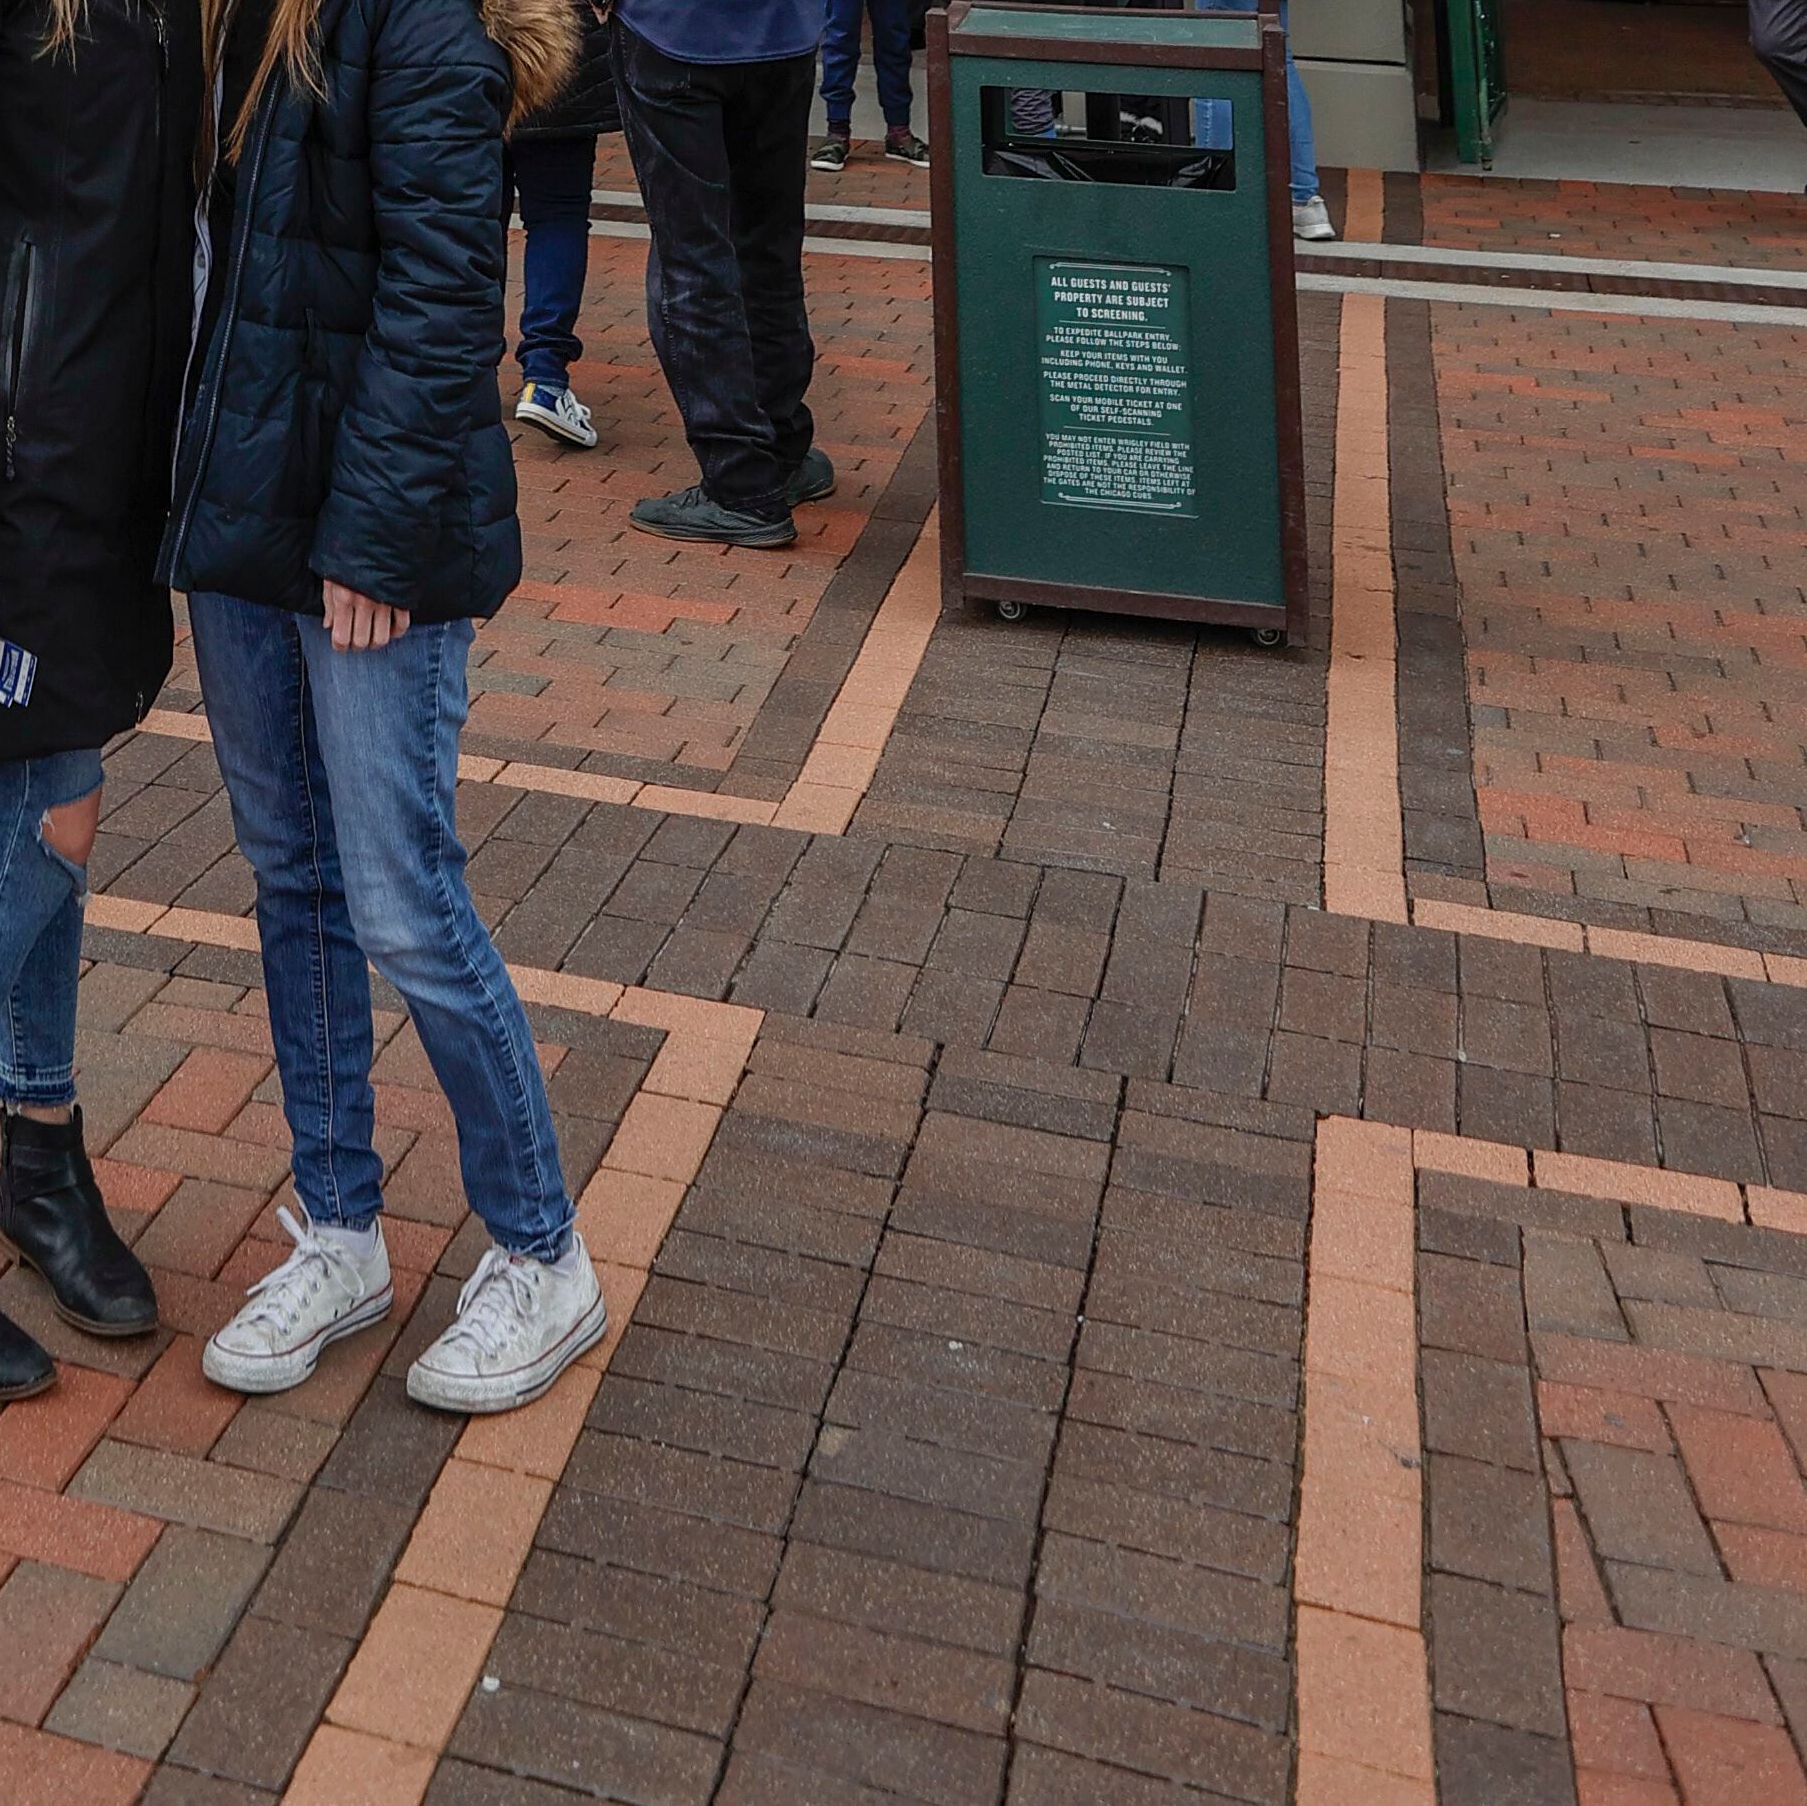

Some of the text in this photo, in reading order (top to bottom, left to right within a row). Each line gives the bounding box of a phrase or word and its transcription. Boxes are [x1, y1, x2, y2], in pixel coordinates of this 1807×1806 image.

[1051, 277, 1170, 292] ALL GUESTS AND GUESTS'
[1055, 292, 1169, 307] PROPERTY ARE SUBJECT
[1076, 308, 1089, 317] TO
[1065, 328, 1102, 337] EXPEDITE
[1103, 330, 1143, 339] BALLPARK
[1046, 335, 1074, 343] PLEASE
[1076, 337, 1107, 345] FOLLOW
[1109, 339, 1123, 347] THE
[1125, 340, 1150, 348] STEPS
[1061, 350, 1080, 358] KEEP
[1082, 351, 1103, 359] YOUR
[1104, 353, 1128, 361] ITEMS
[1129, 354, 1150, 362] WITH
[1042, 357, 1083, 366] INCLUDING
[1115, 362, 1135, 370] KEYS
[1136, 363, 1153, 371] AND
[1044, 372, 1186, 387] PLEASE PROCEED DIRECTLY THROUGH
[1067, 382, 1092, 390] METAL
[1094, 383, 1134, 392] DETECTOR
[1050, 394, 1182, 410] SCAN YOUR MOBILE TICKET AT ONE
[1082, 405, 1099, 413] OUR
[1100, 407, 1162, 417] SELF-SCANNING
[1079, 414, 1106, 422] TICKET
